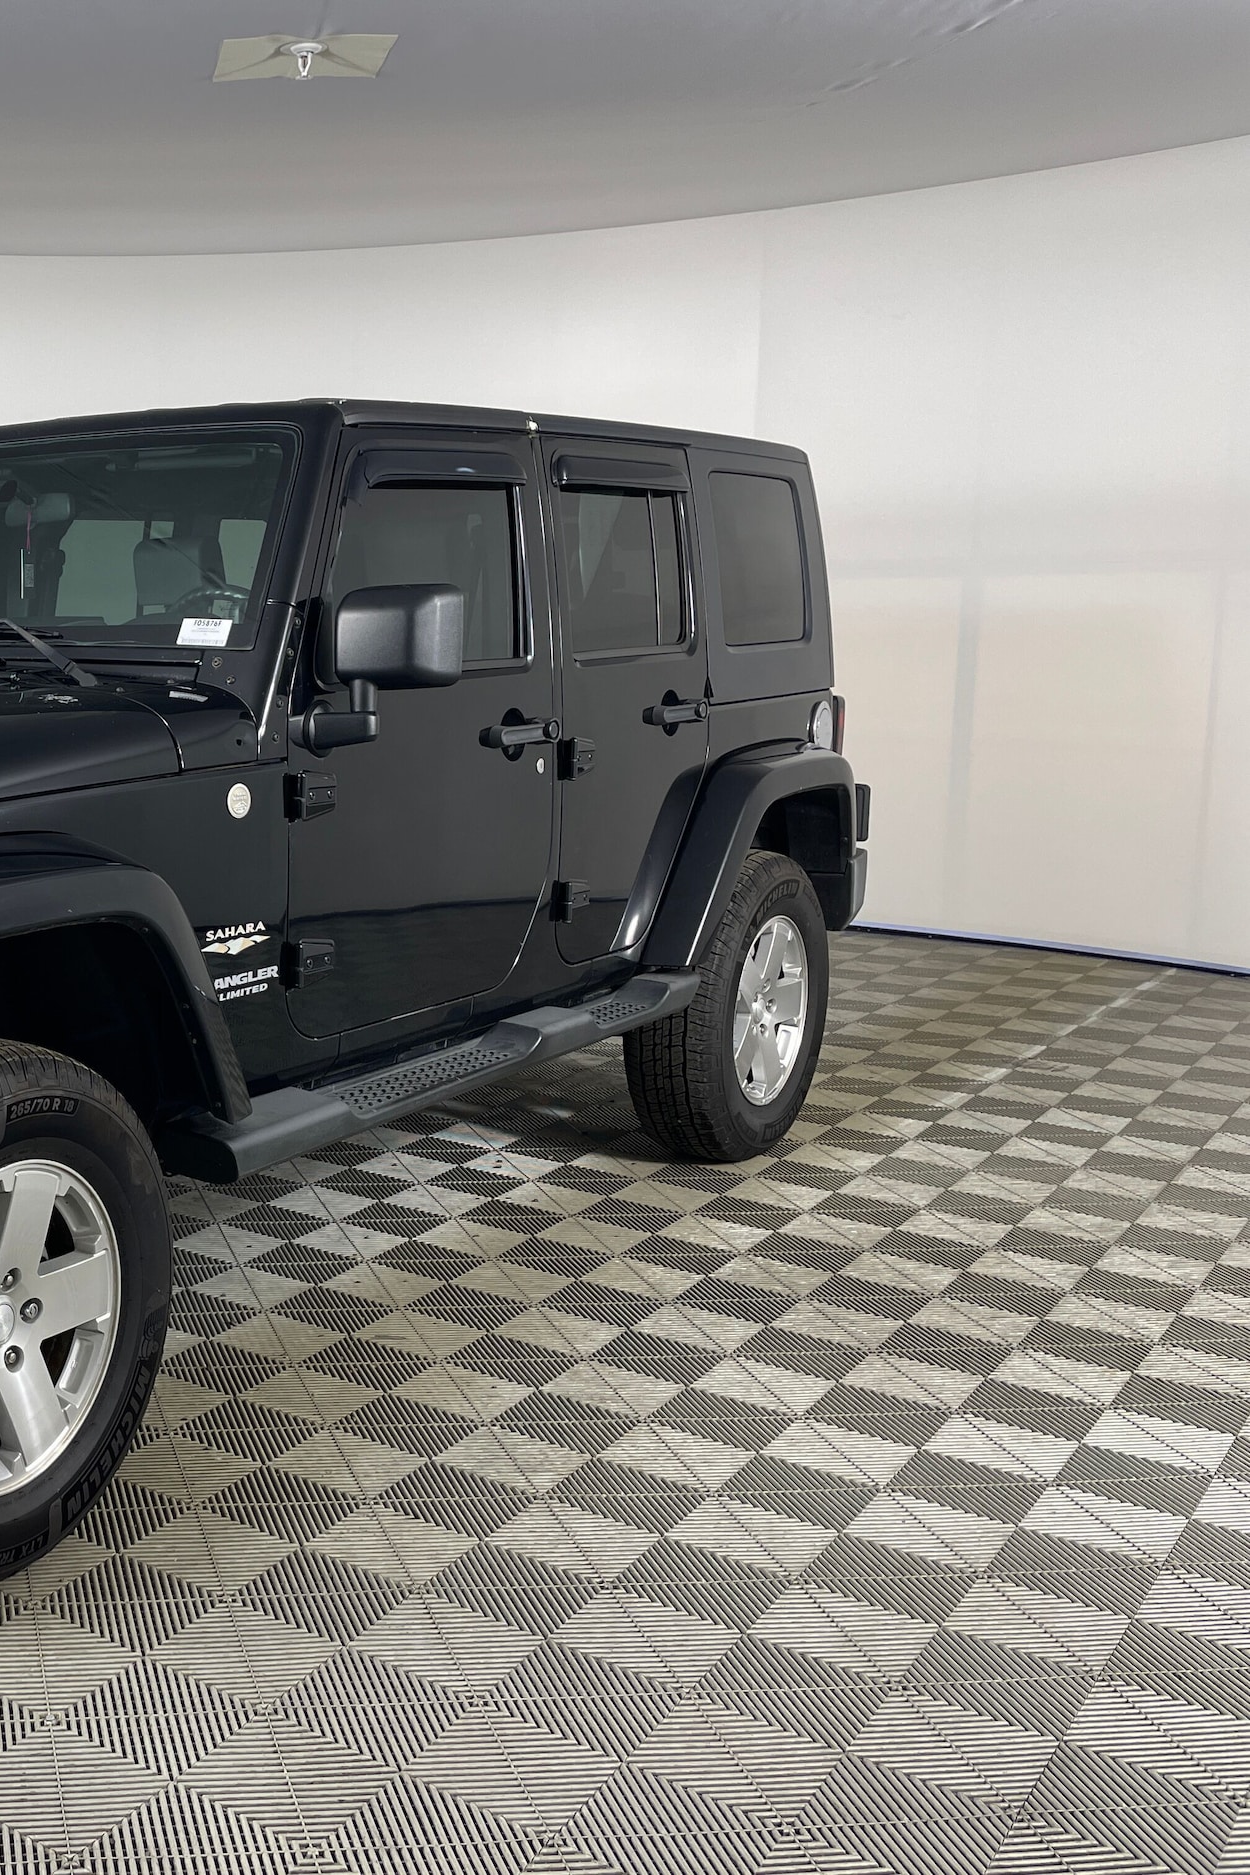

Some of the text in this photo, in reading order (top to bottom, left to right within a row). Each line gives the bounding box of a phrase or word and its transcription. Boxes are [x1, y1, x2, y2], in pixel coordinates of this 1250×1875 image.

[206, 921, 266, 941] SAHARA
[214, 966, 279, 990] ANGLER
[219, 983, 268, 1001] LIMITED
[11, 1098, 74, 1116] 265/70 R 18
[66, 1365, 151, 1522] MICHELIN
